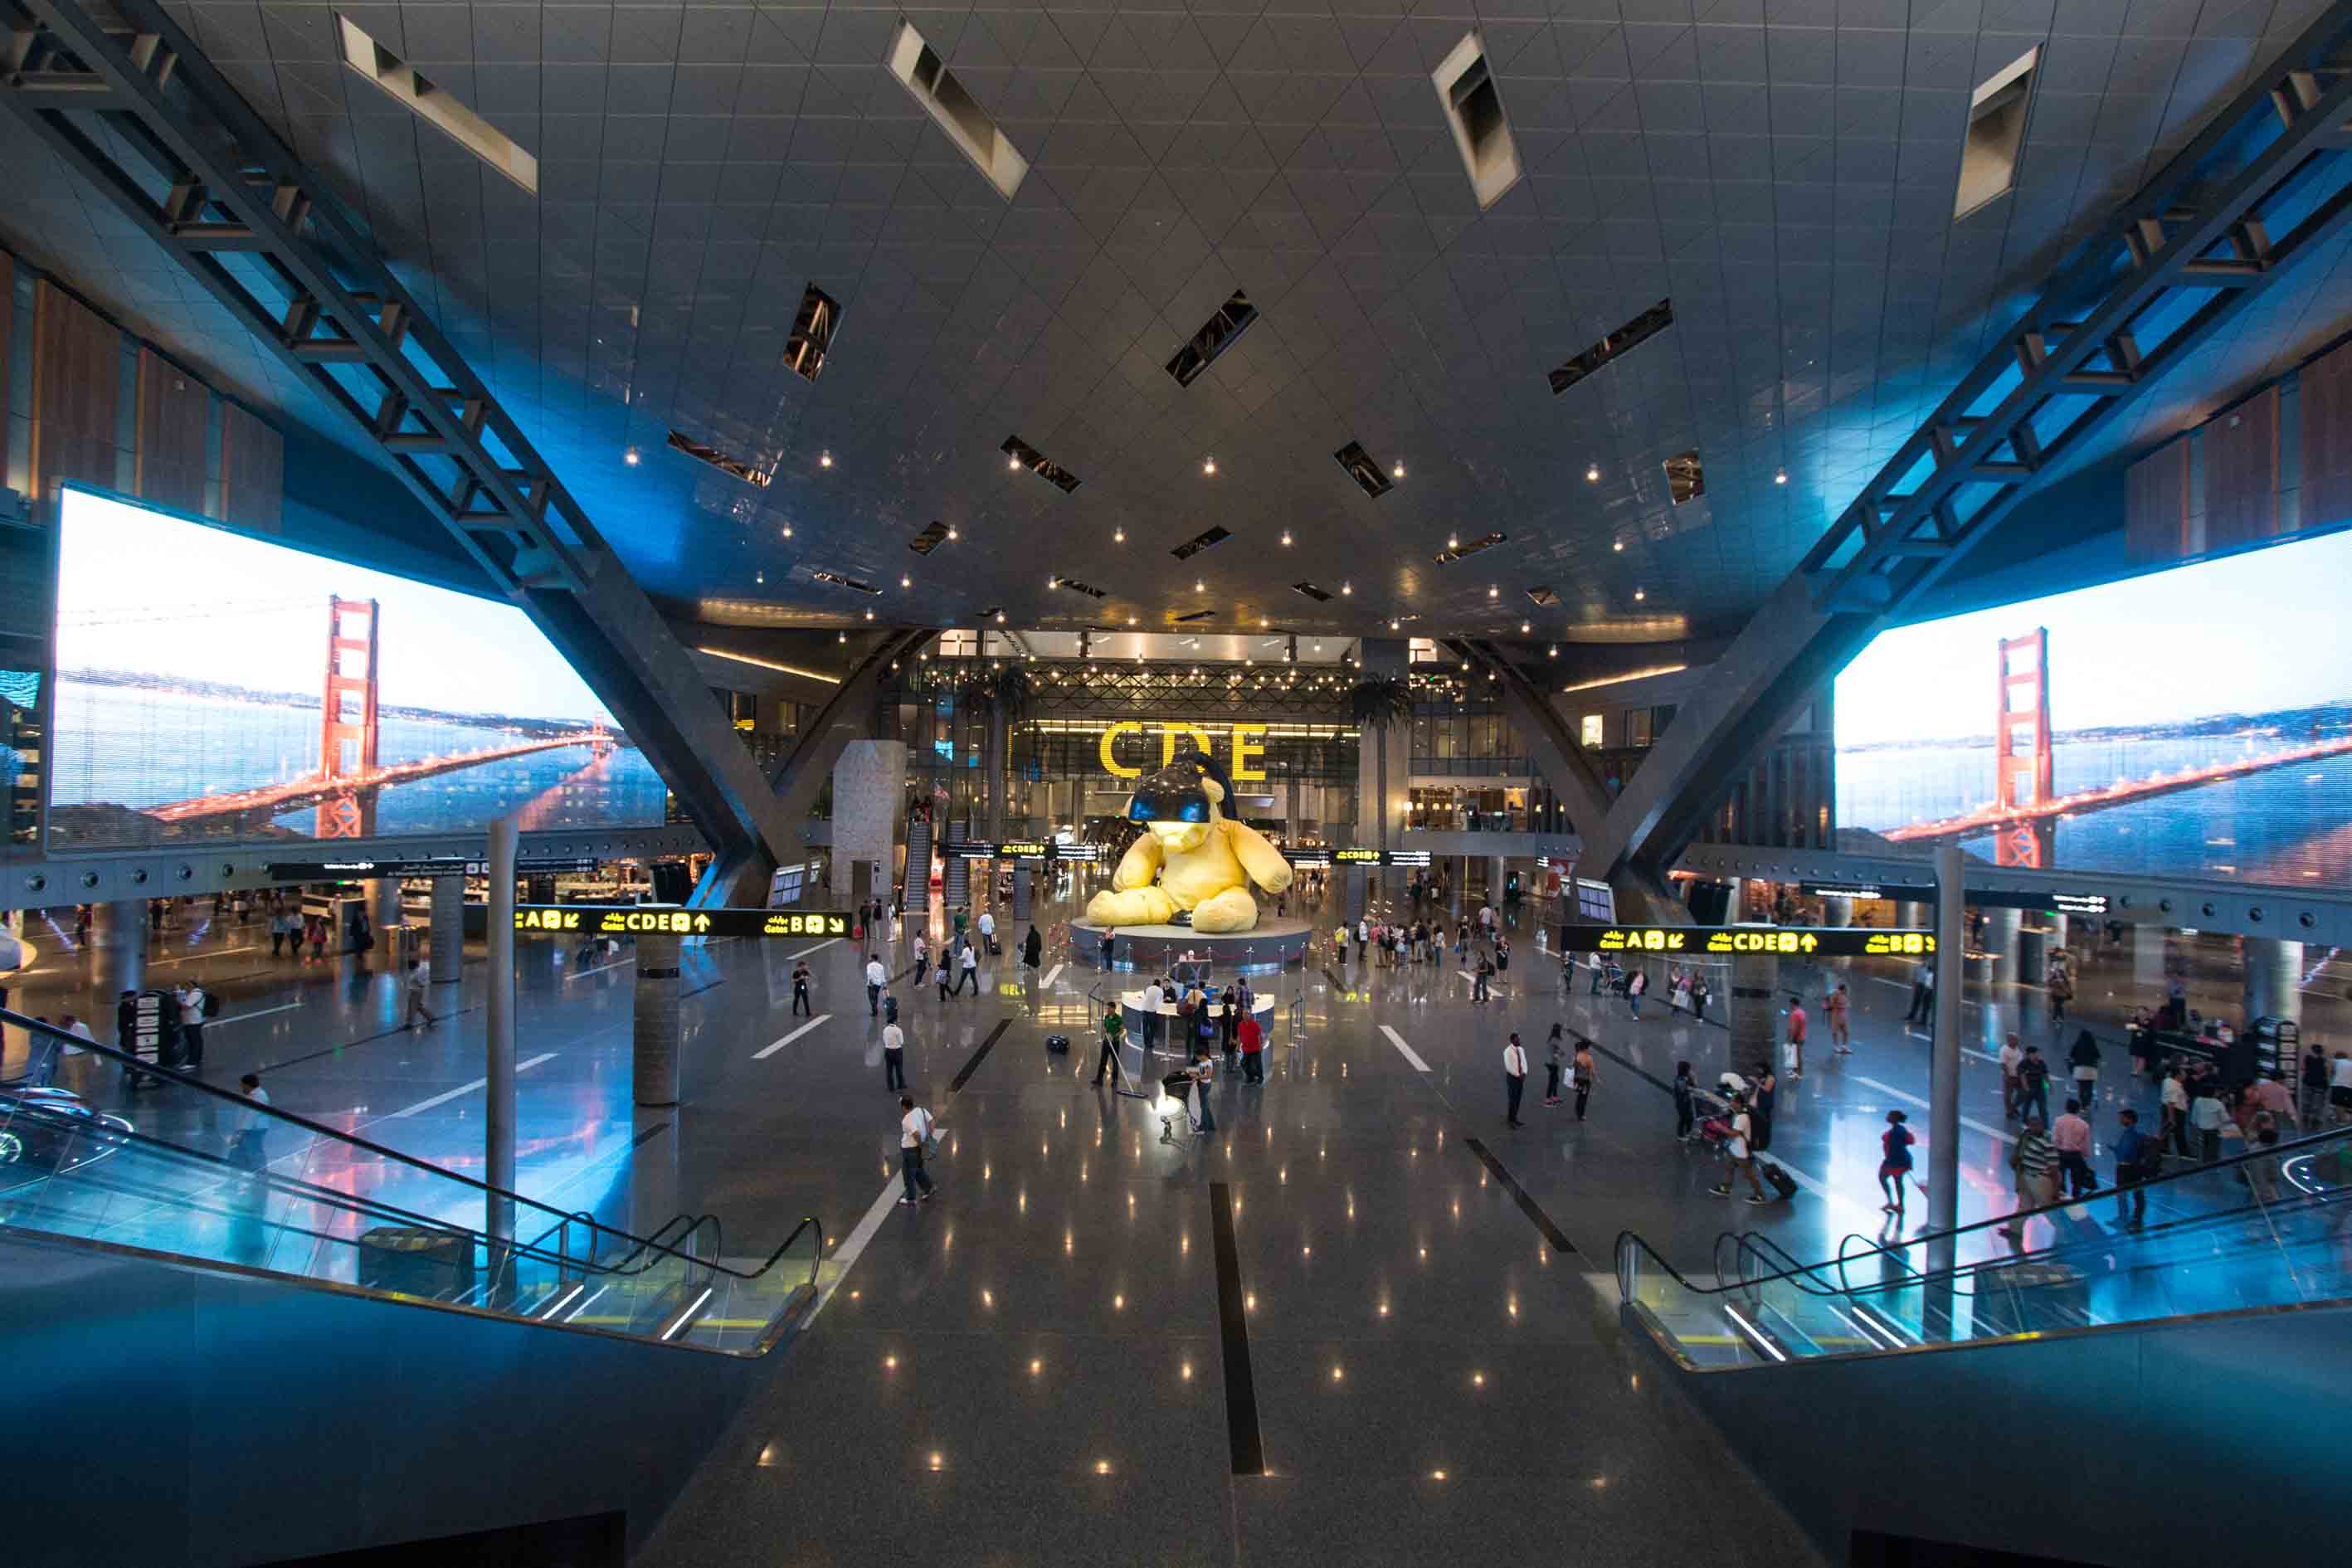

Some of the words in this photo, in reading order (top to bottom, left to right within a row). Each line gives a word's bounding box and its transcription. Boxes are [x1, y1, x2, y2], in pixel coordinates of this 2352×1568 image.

[525, 911, 540, 928] A
[601, 922, 625, 931] Gates
[626, 913, 670, 930] CDE
[764, 925, 788, 933] Gates
[791, 917, 802, 932] B
[1600, 940, 1624, 948] Gates
[1627, 932, 1643, 948] A
[1733, 933, 1777, 950] CDE
[1890, 935, 1902, 952] B
